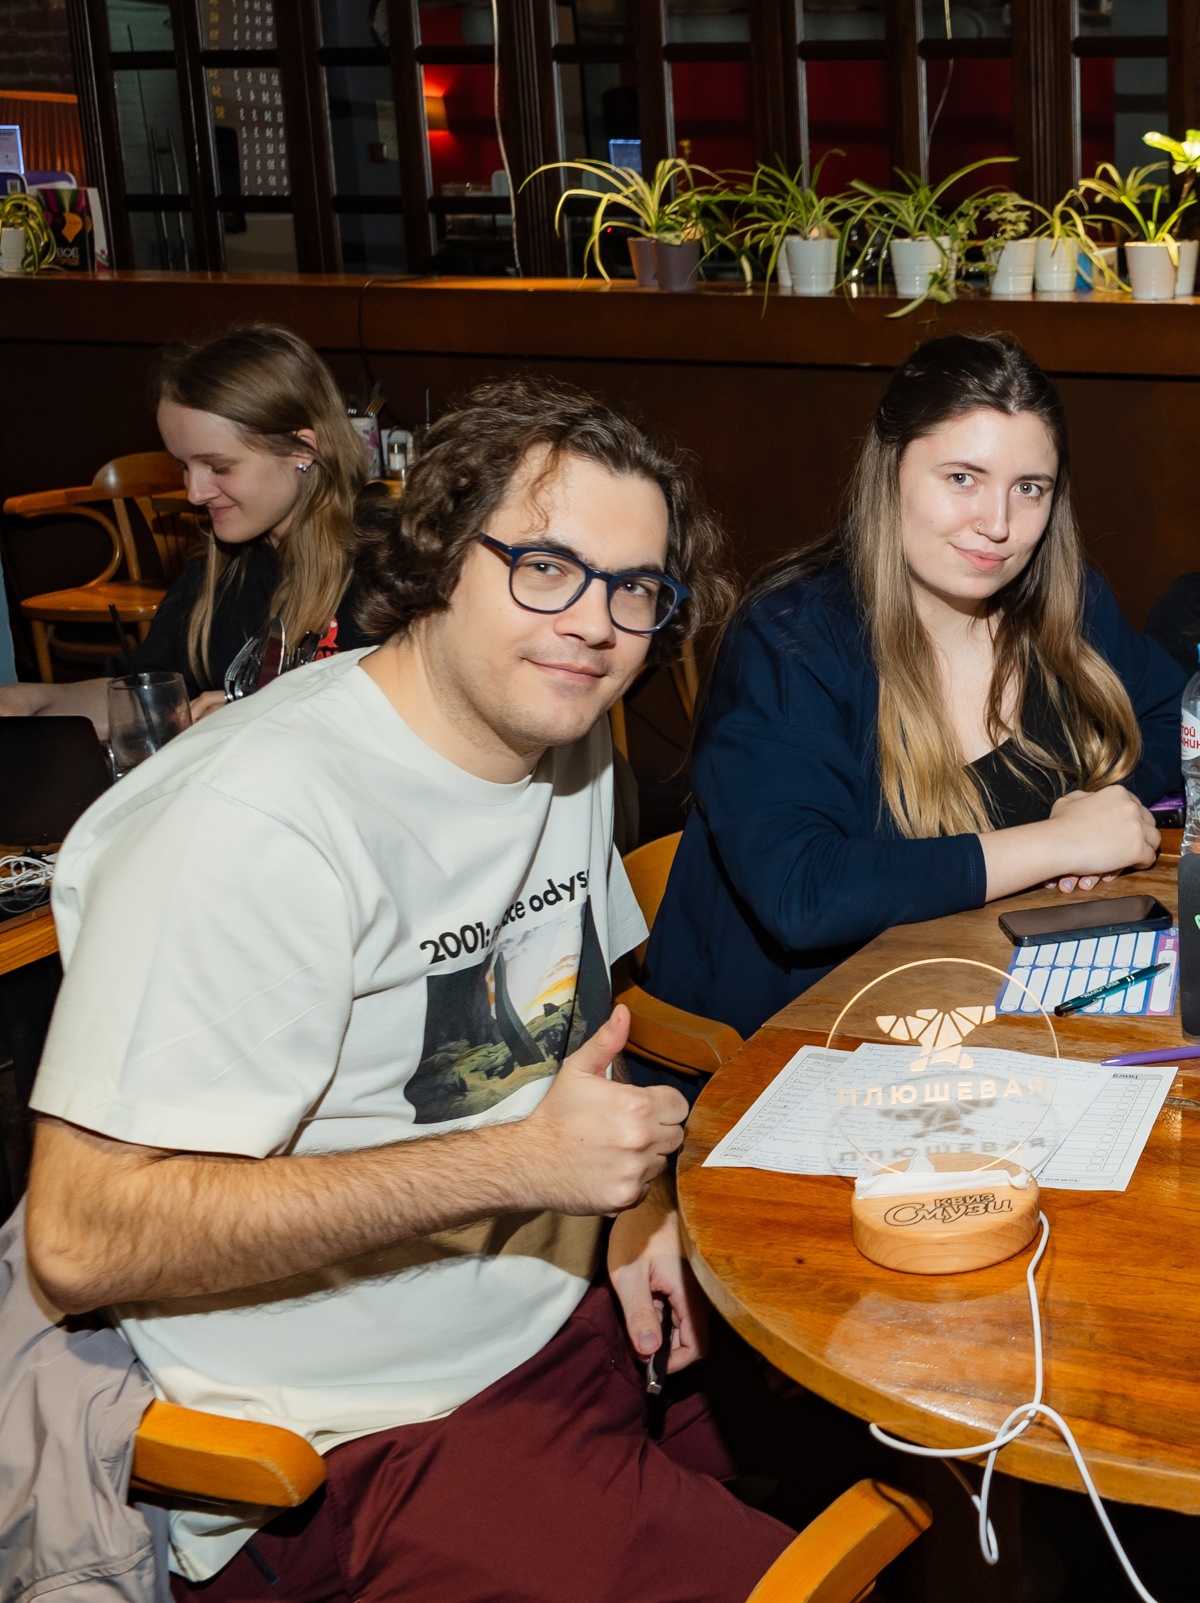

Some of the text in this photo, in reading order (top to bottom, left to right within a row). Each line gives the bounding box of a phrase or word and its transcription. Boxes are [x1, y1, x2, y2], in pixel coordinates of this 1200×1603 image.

[837, 1076, 1046, 1108] ПЛЮШЕВАЯ
[884, 1199, 1013, 1227] Смузи
[934, 1193, 995, 1207] КВИЗ
